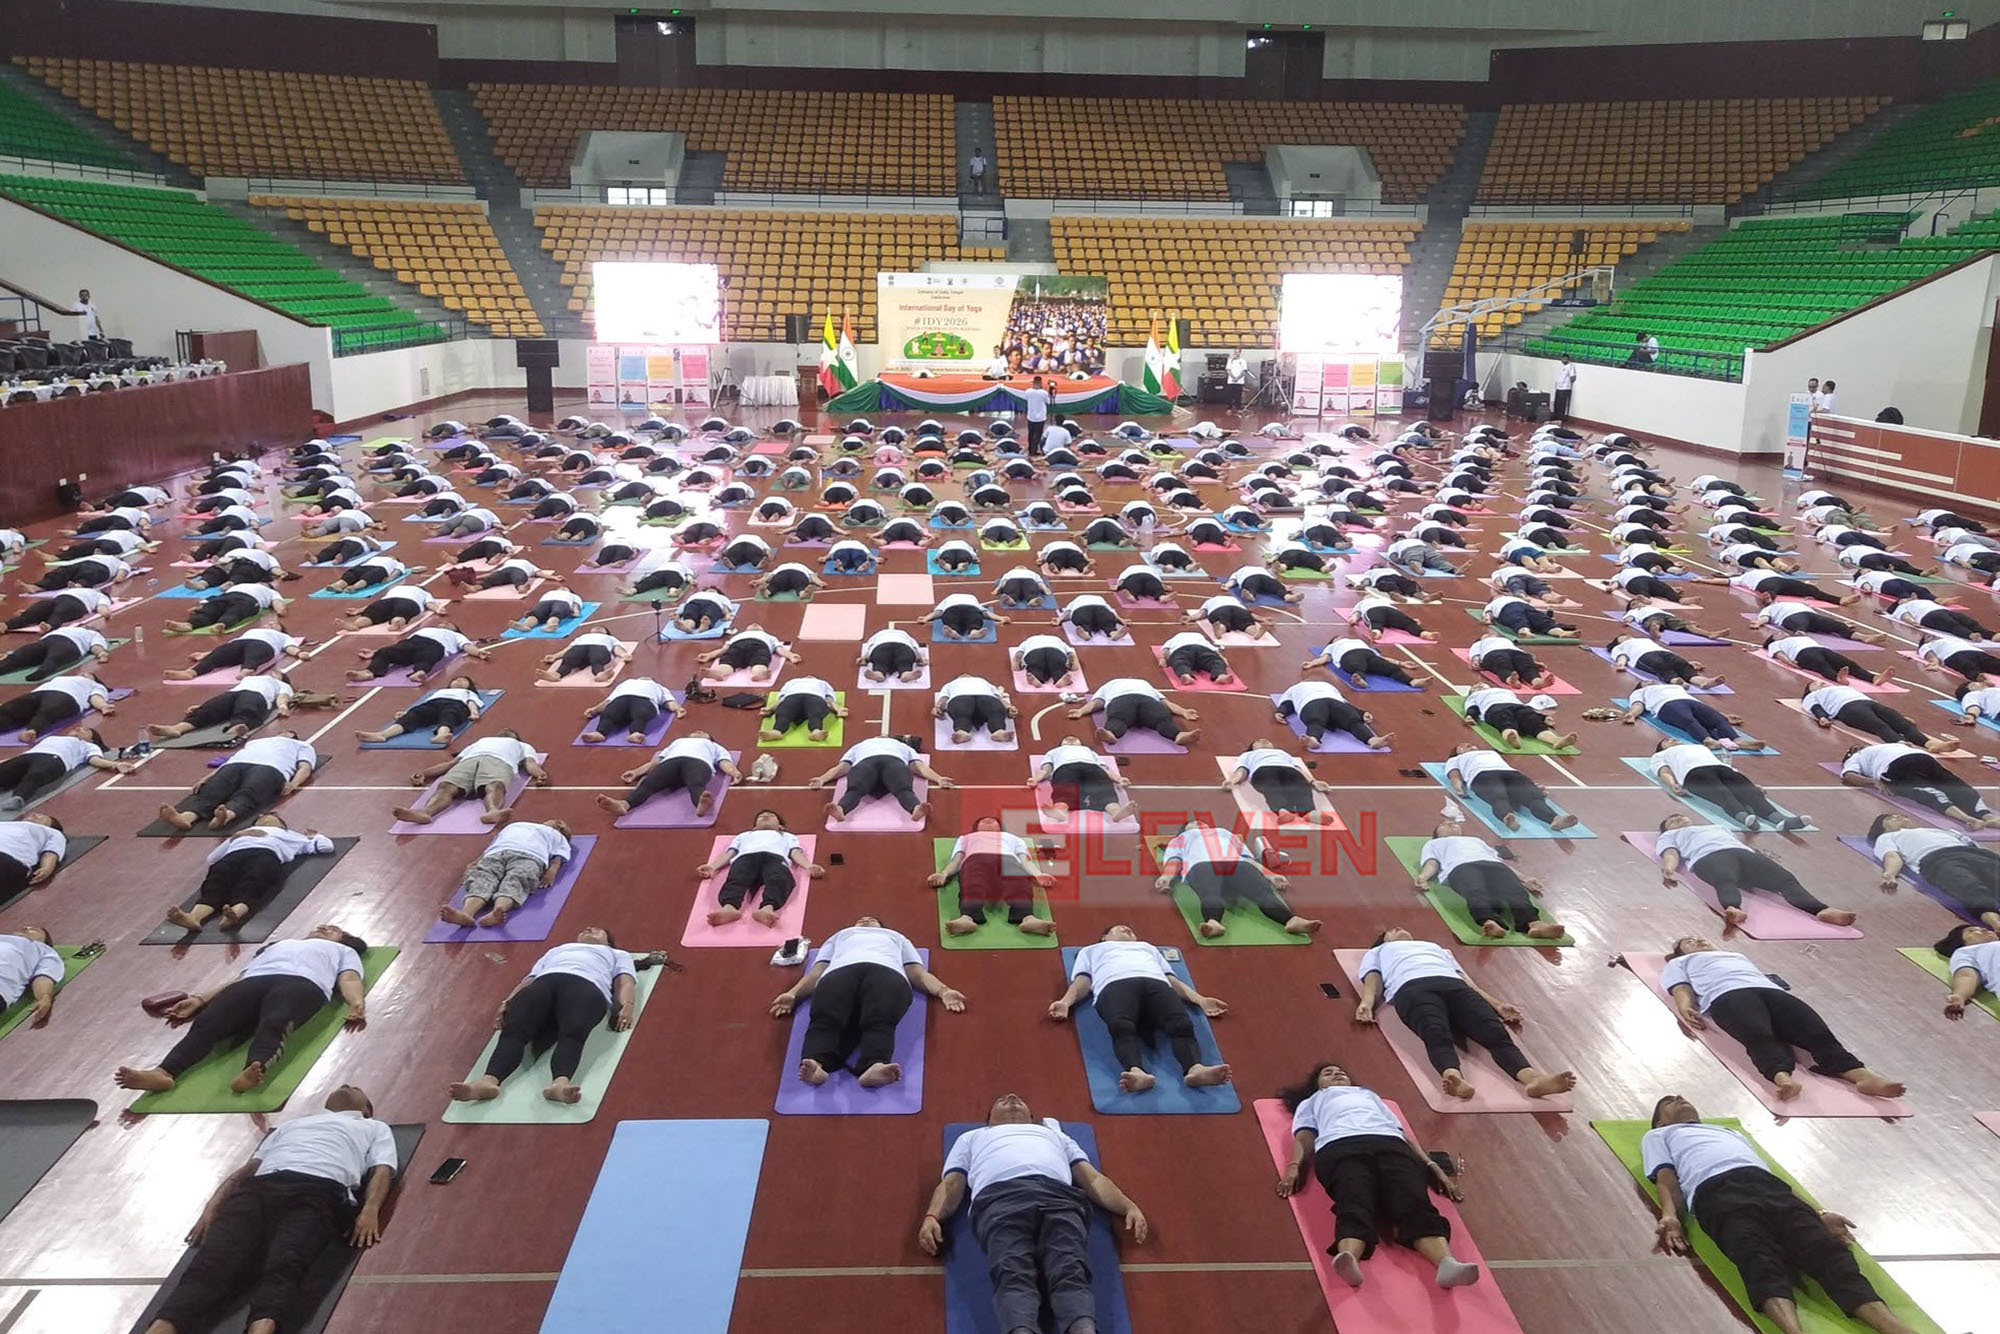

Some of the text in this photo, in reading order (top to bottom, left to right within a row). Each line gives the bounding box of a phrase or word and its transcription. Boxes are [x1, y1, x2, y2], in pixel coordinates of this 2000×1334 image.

[899, 304, 942, 312] International
[943, 304, 956, 313] Day
[966, 305, 983, 313] Yoga
[914, 317, 968, 326] #IDY2026
